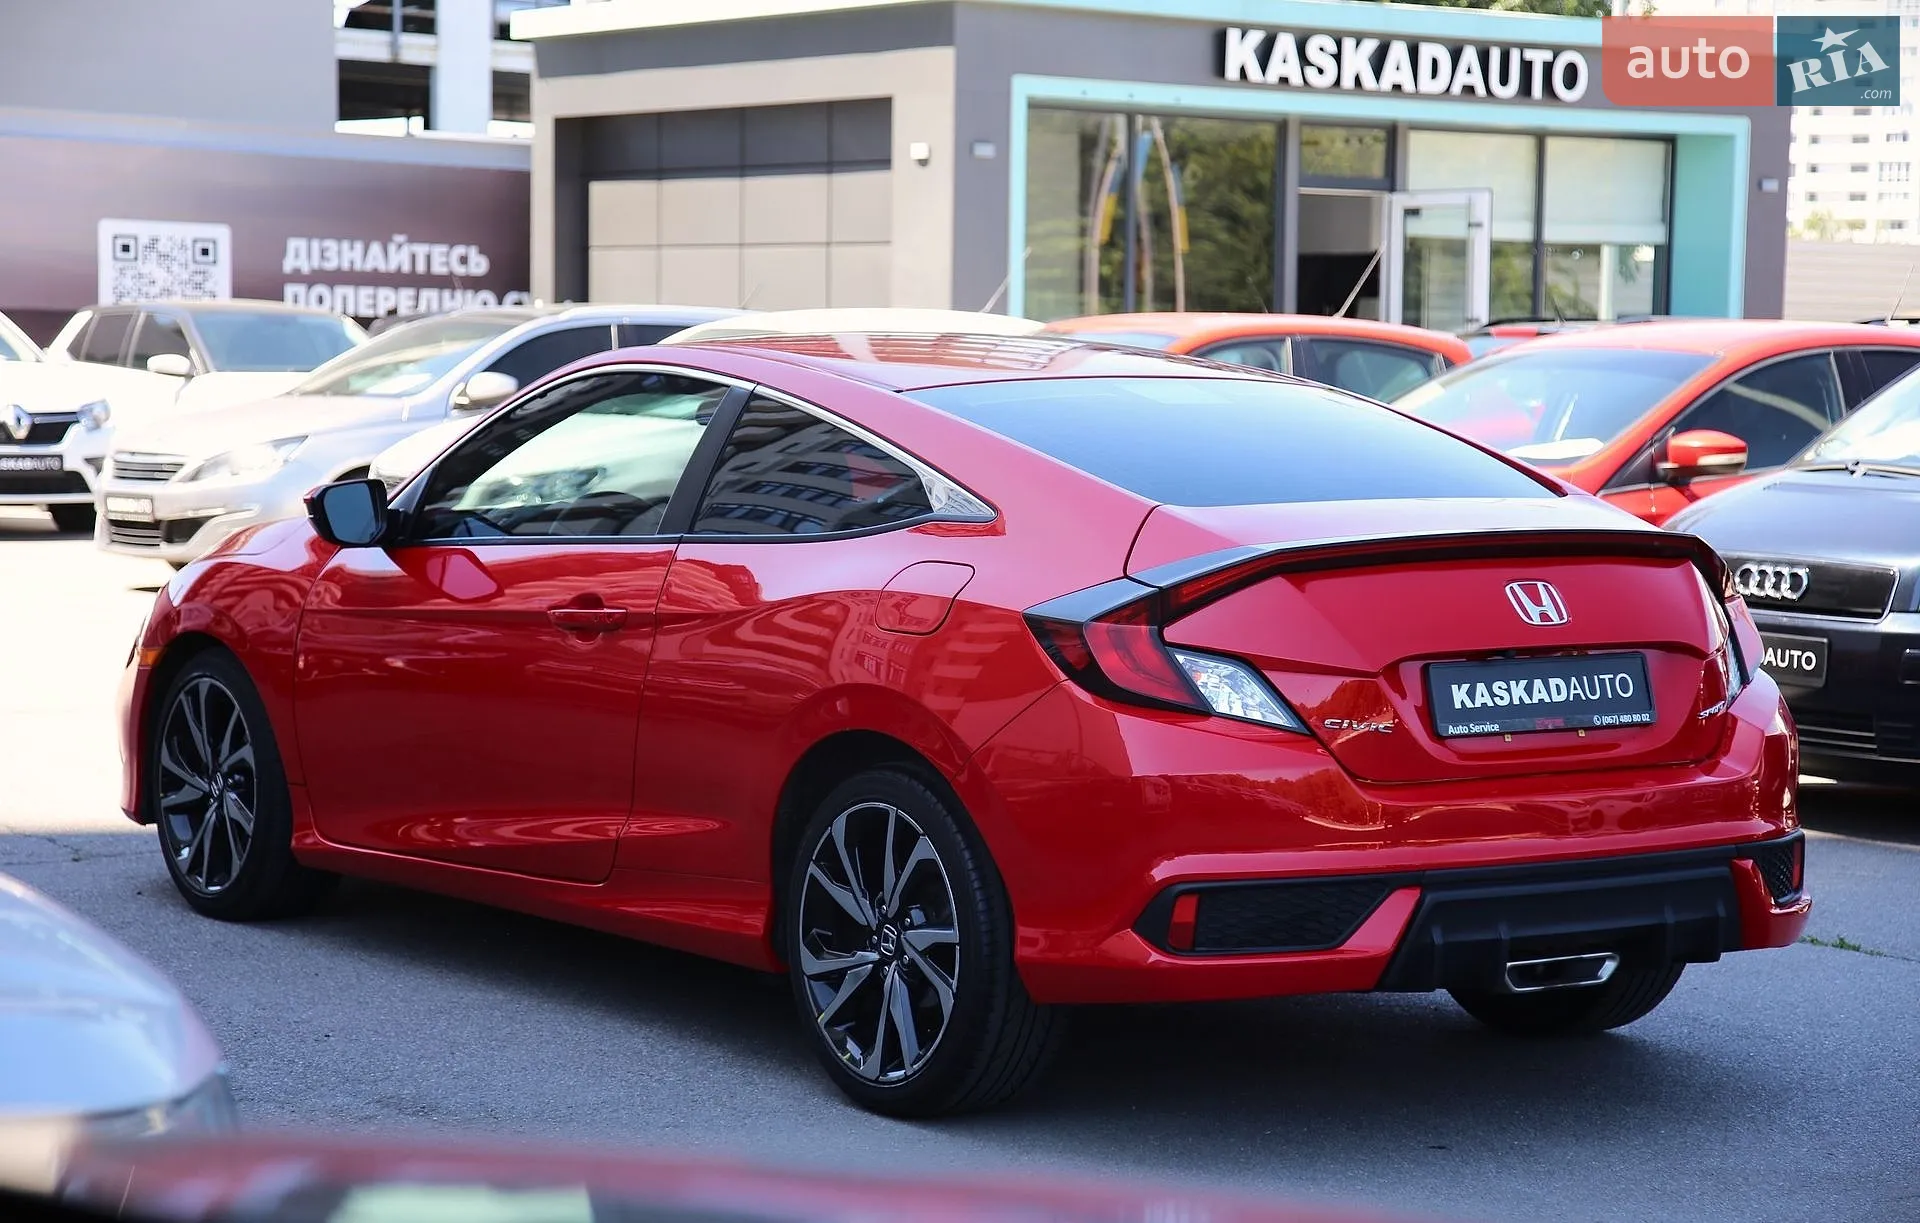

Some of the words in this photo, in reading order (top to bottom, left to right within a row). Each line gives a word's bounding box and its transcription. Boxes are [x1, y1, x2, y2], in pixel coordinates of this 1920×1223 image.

[1224, 27, 1589, 102] KASKADAUTO
[283, 234, 490, 277] ДІЗНАЙТЕСЬ
[1764, 647, 1817, 671] AUTO
[1451, 672, 1634, 709] KASKADAUTO
[1324, 718, 1394, 733] CIVIC
[1448, 725, 1468, 735] Auto
[1469, 722, 1500, 733] Service
[1602, 714, 1619, 725] (067)
[1642, 713, 1650, 721] 02
